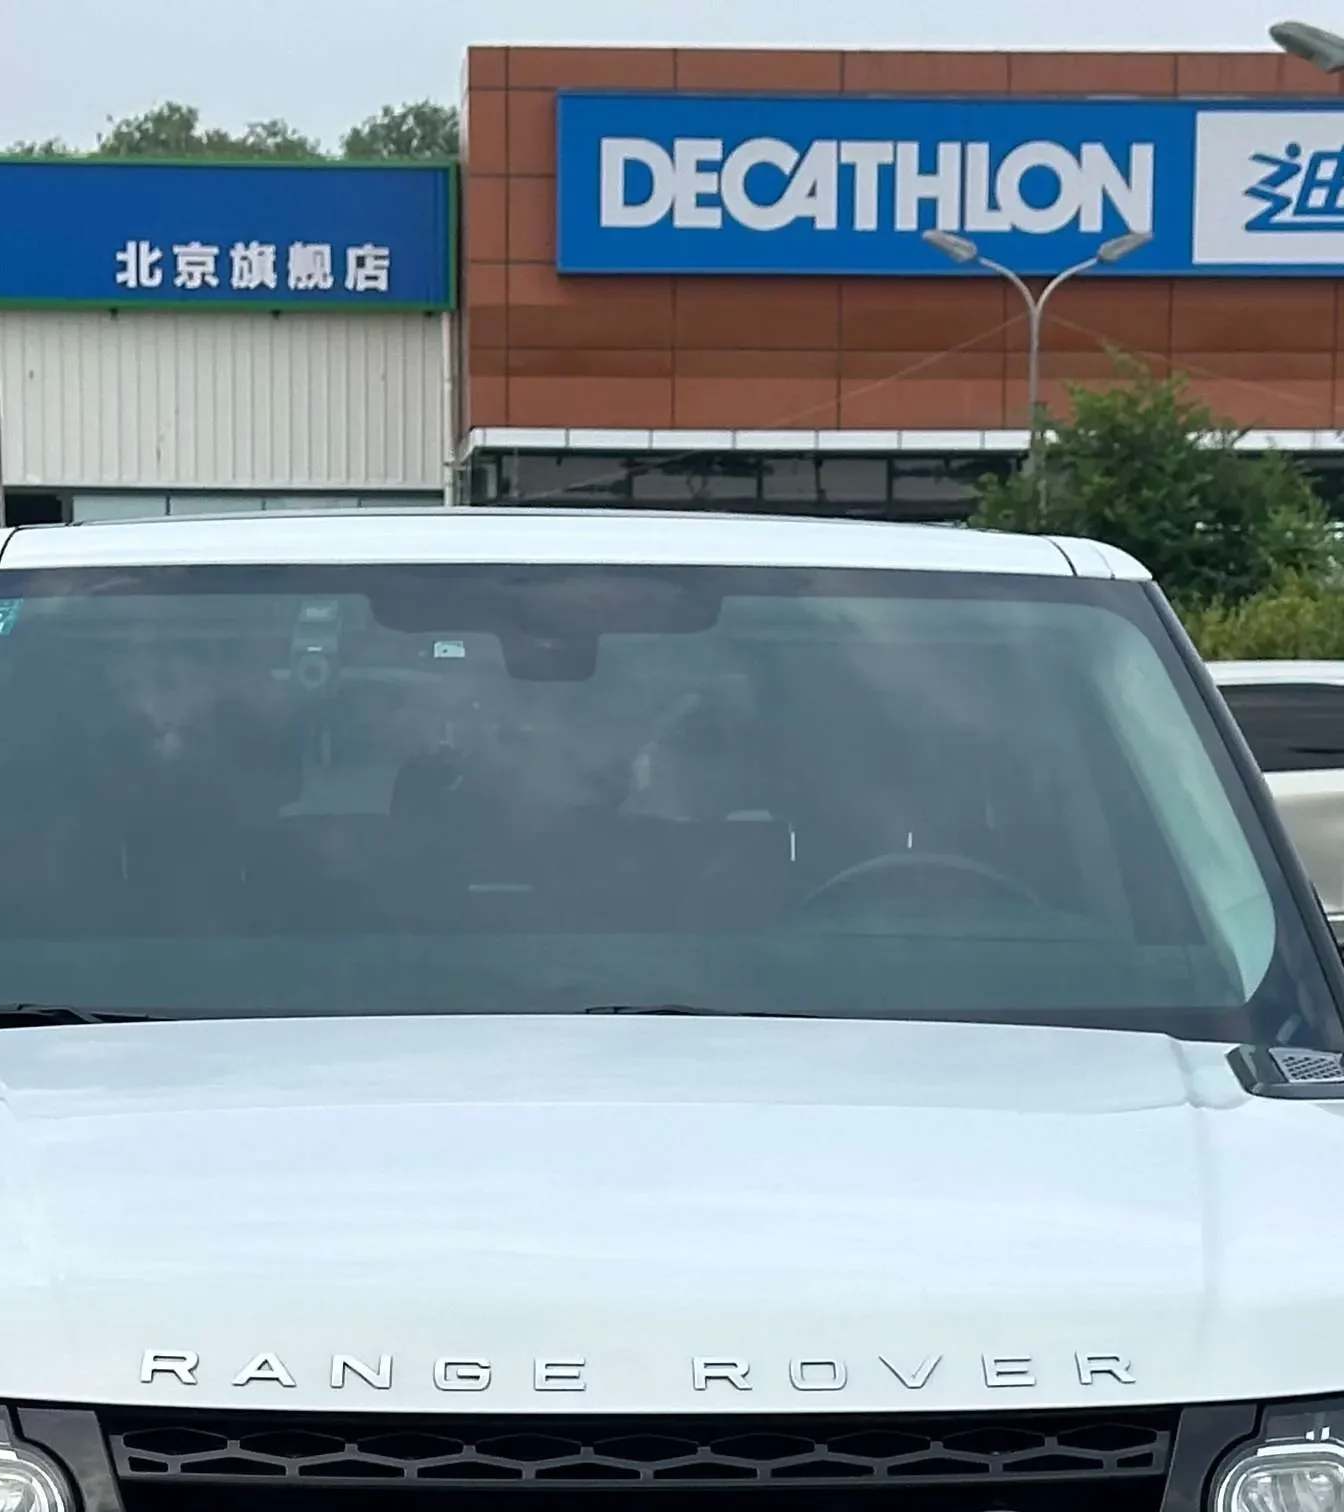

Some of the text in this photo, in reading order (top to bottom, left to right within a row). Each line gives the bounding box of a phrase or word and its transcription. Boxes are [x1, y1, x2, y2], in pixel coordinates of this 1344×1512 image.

[599, 137, 1154, 232] DECATHLON
[115, 241, 391, 291] 北京旗舰店
[138, 1348, 1137, 1392] RANGE ROVER
